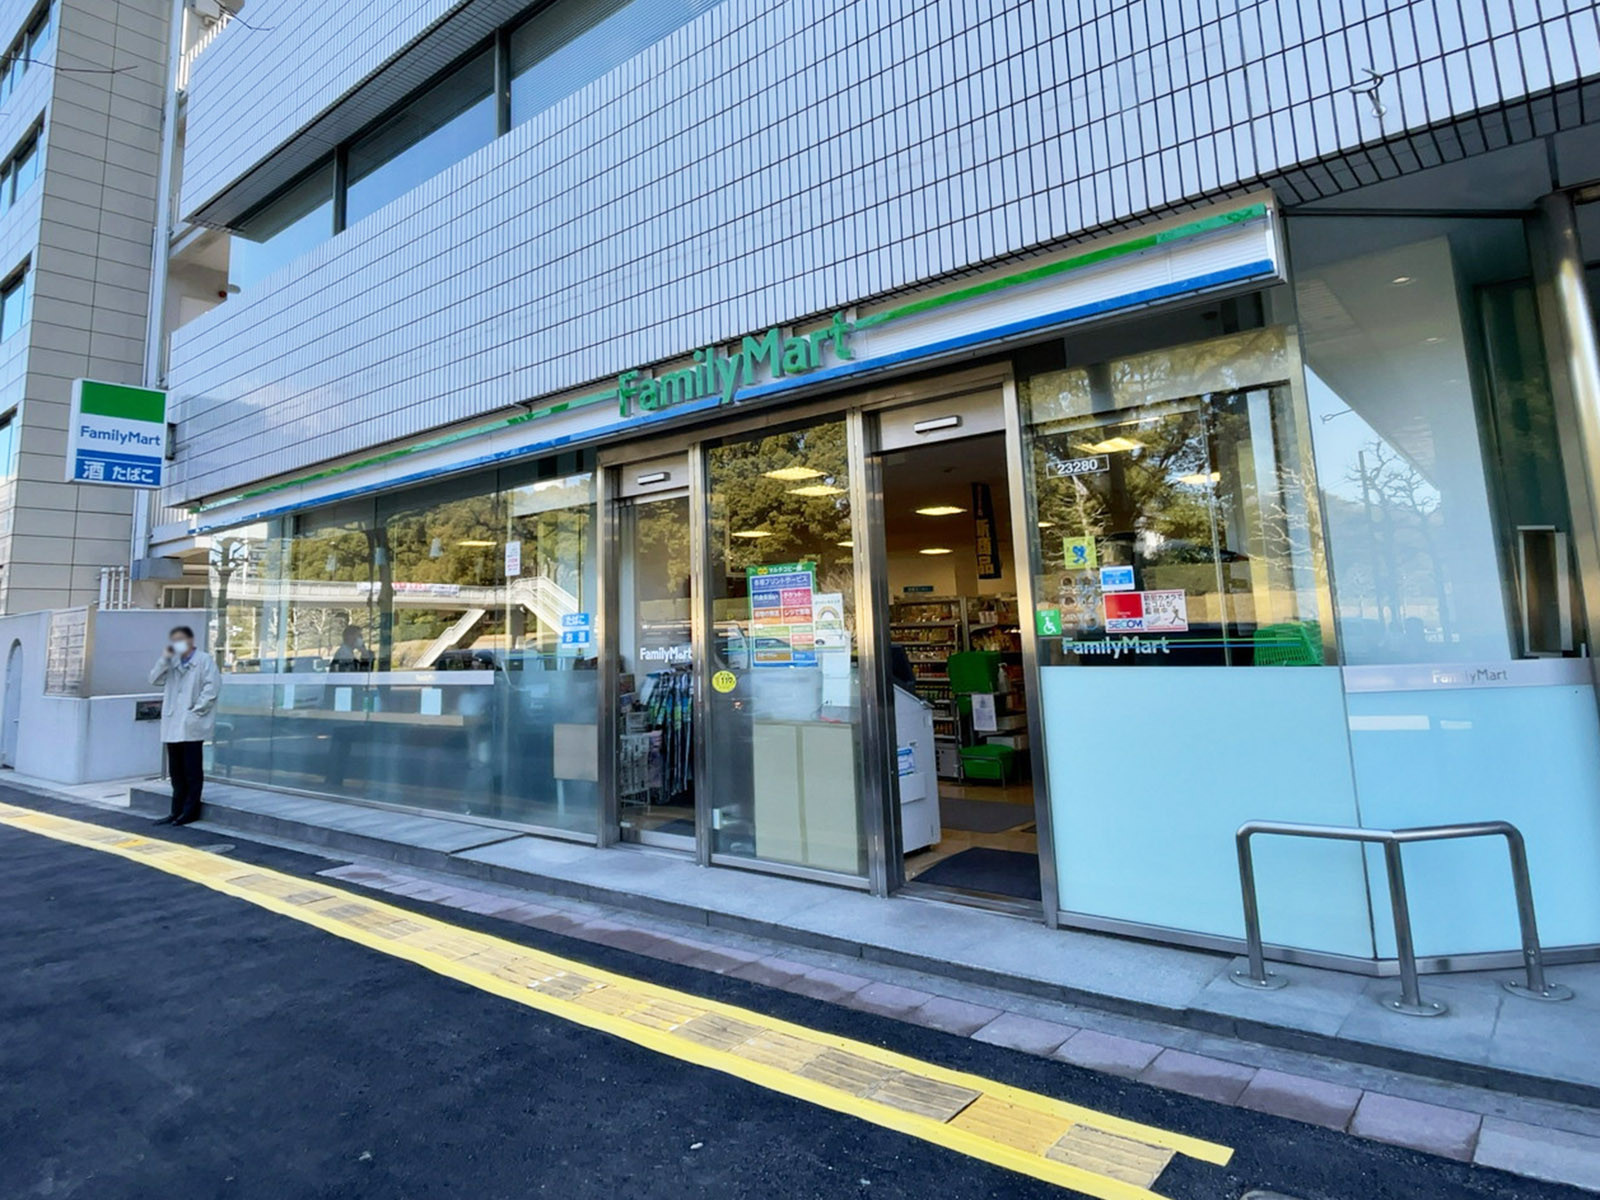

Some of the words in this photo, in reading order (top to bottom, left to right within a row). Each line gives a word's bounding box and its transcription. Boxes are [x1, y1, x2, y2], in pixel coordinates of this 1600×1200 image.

[618, 312, 855, 418] FamilyMart
[80, 425, 161, 446] FamilyMart
[82, 460, 106, 480] 酒
[112, 466, 154, 483] たばこ
[1057, 458, 1098, 475] 23280
[768, 564, 803, 573] マルチコピー
[1107, 619, 1144, 630] SECOM
[640, 646, 693, 663] FamilyMart
[1062, 636, 1171, 659] FamilyMart
[1432, 668, 1508, 685] FamlyMart
